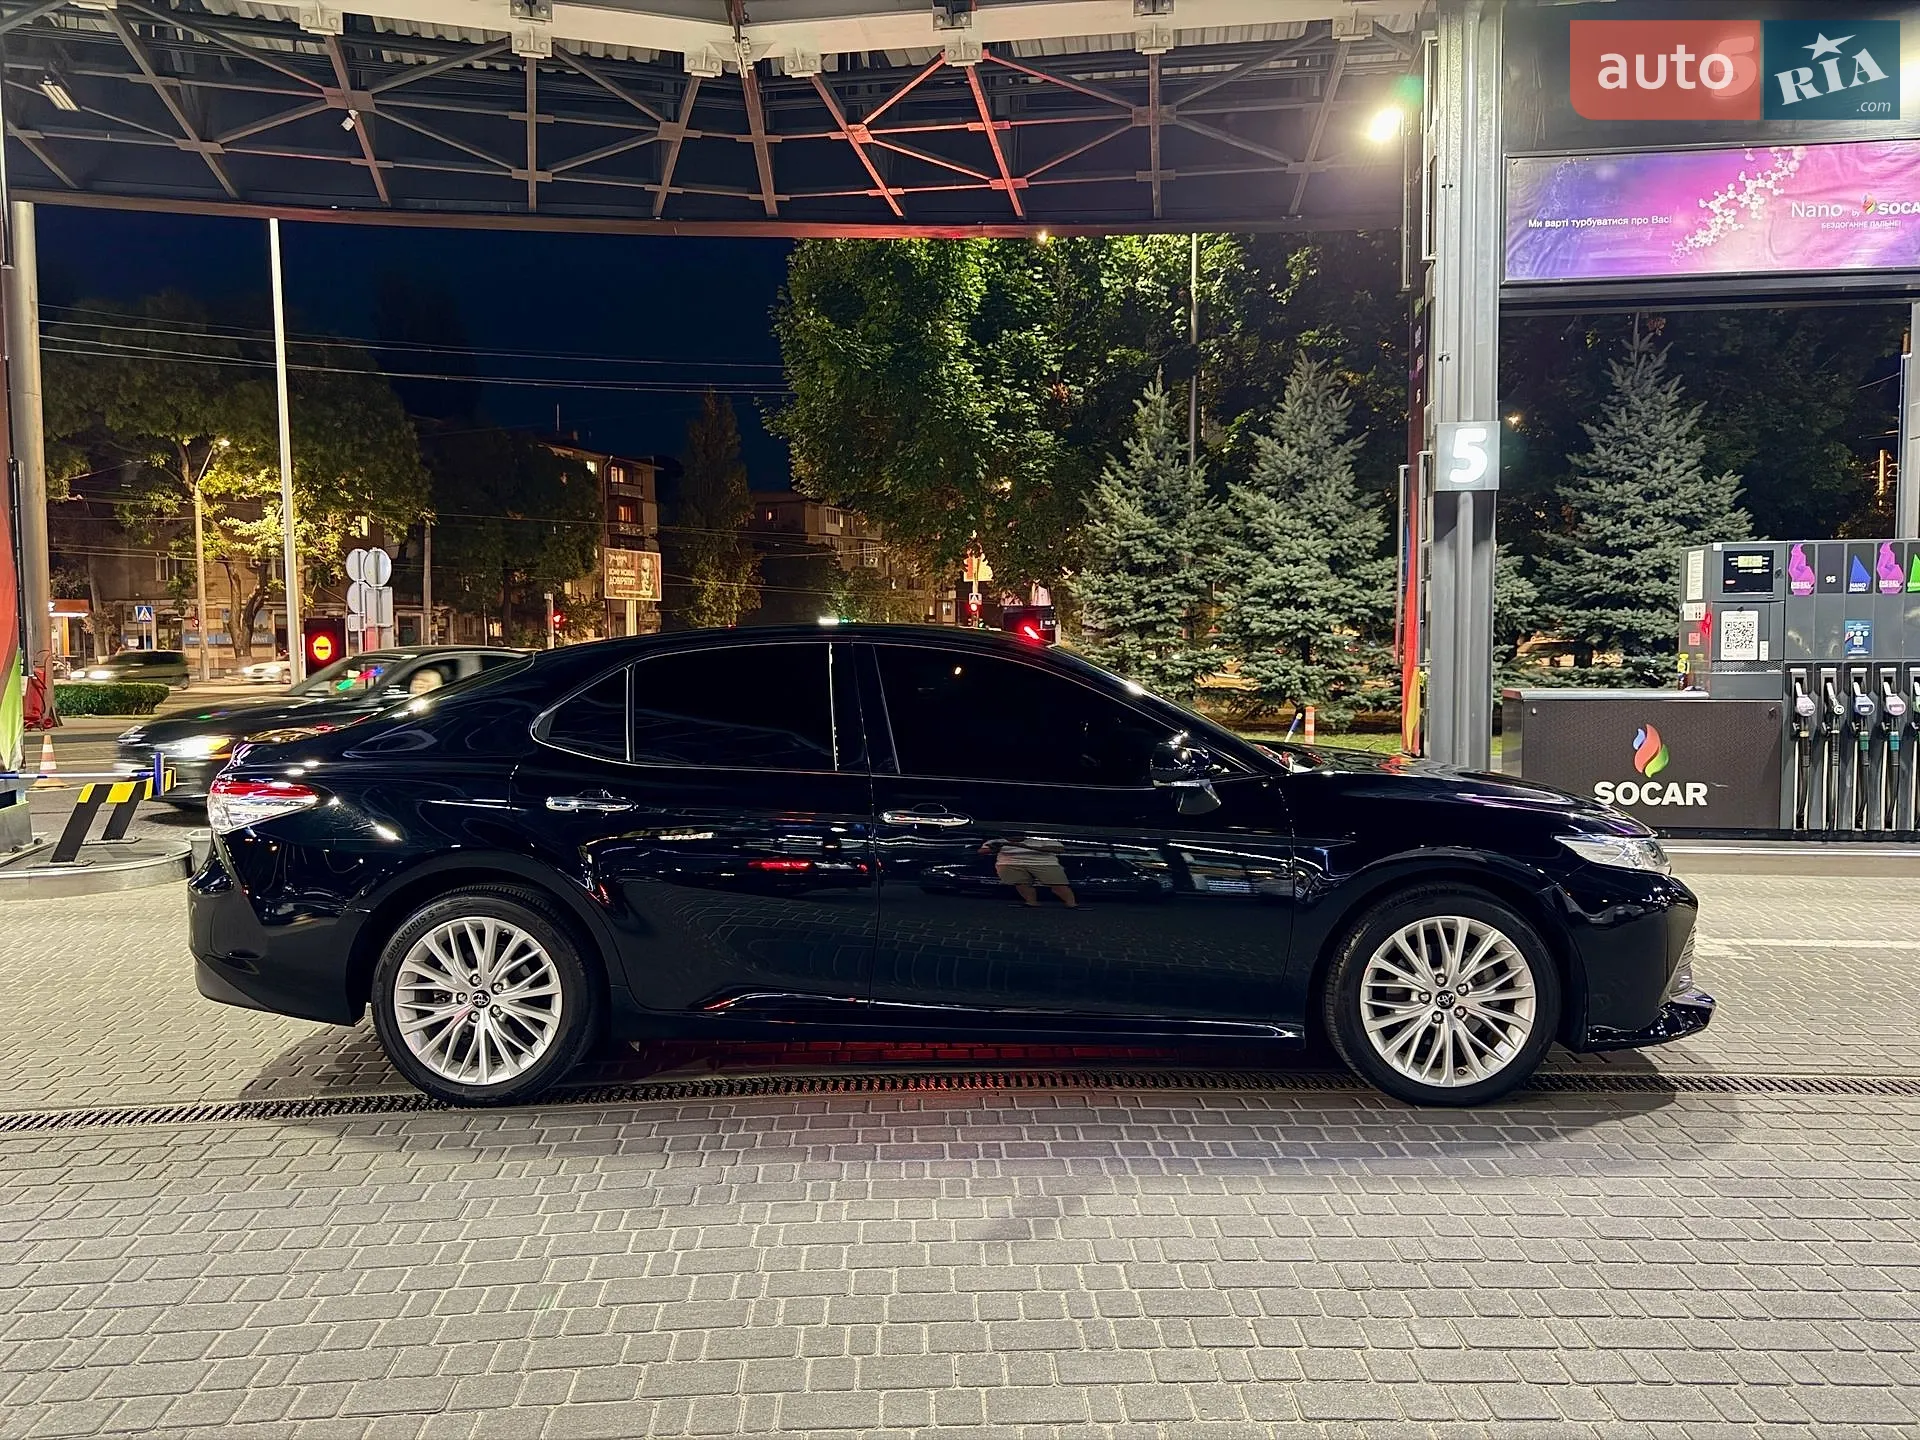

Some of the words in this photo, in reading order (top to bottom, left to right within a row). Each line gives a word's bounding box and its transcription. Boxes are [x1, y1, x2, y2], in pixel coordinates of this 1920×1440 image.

[1791, 201, 1843, 218] Nano
[1528, 219, 1543, 228] Ми
[1545, 218, 1569, 229] варті
[1571, 217, 1629, 229] турбуватися
[1631, 218, 1649, 226] про
[1651, 215, 1673, 224] Вас!
[1450, 428, 1488, 483] 5
[1594, 781, 1708, 806] SOCAR
